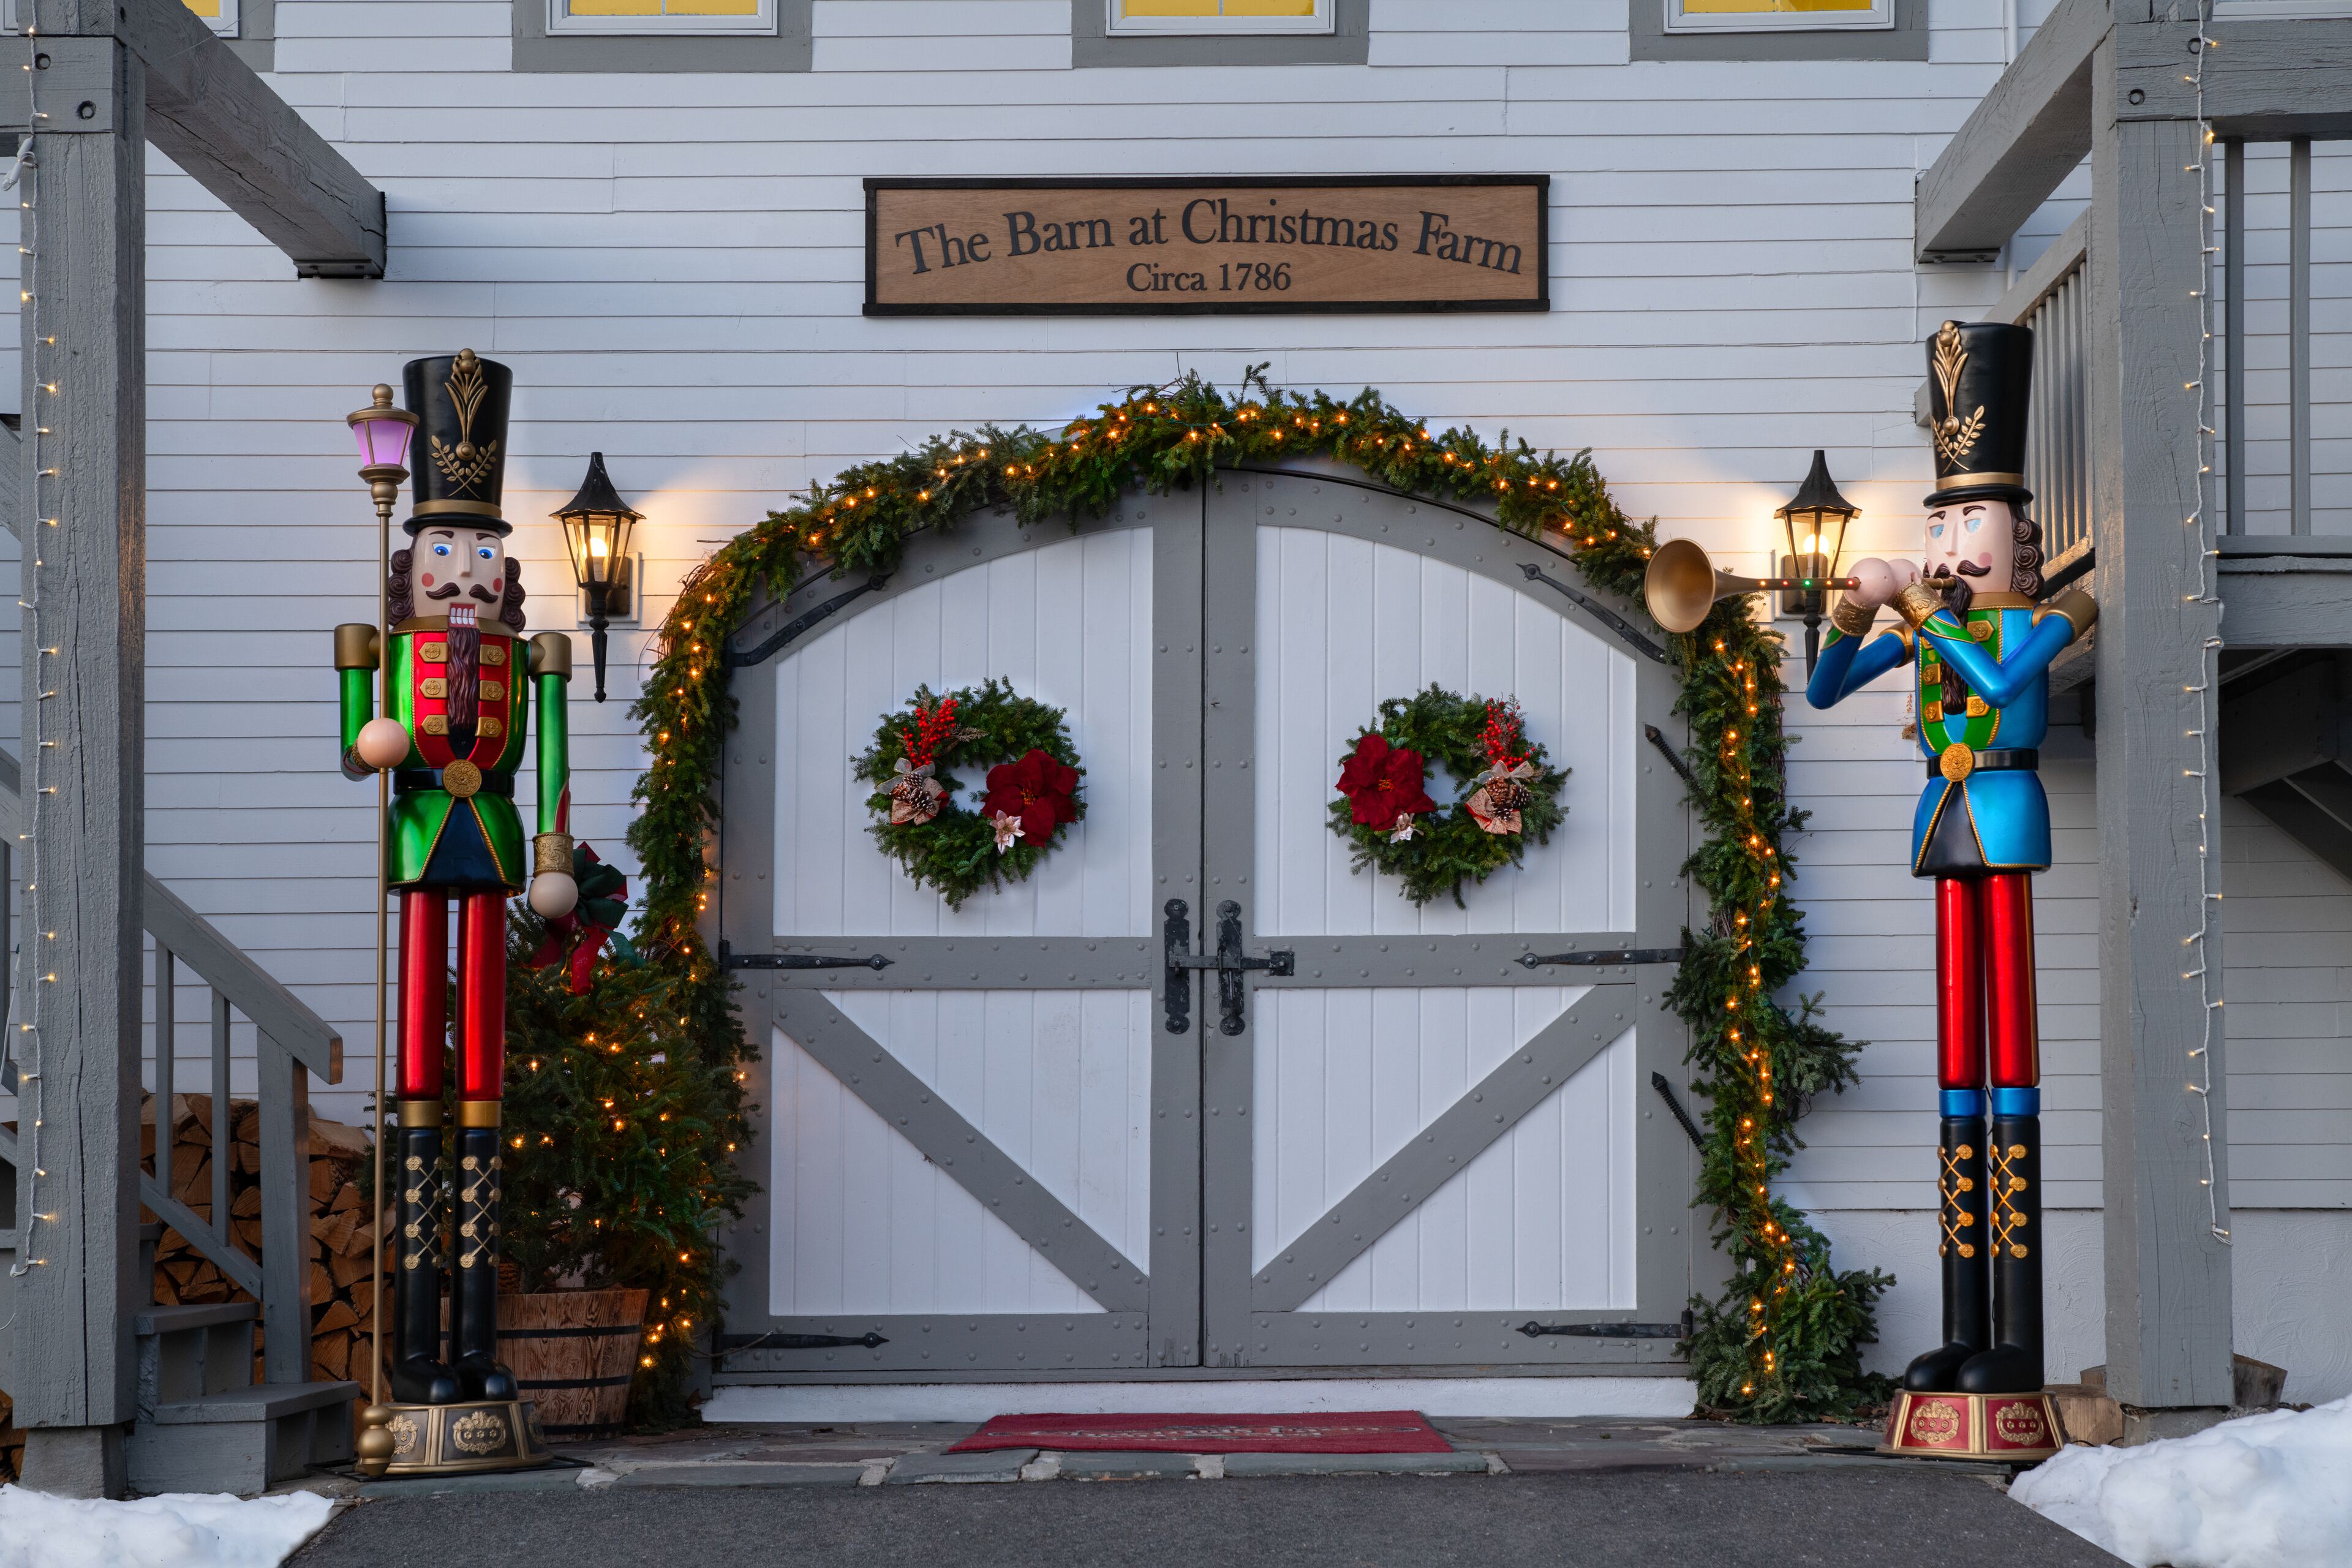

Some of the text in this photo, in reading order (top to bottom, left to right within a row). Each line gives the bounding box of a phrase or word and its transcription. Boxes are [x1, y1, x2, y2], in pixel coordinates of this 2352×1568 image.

[895, 198, 1521, 274] The Barn at Christmas Farm
[1127, 263, 1291, 292] Circa 1786
